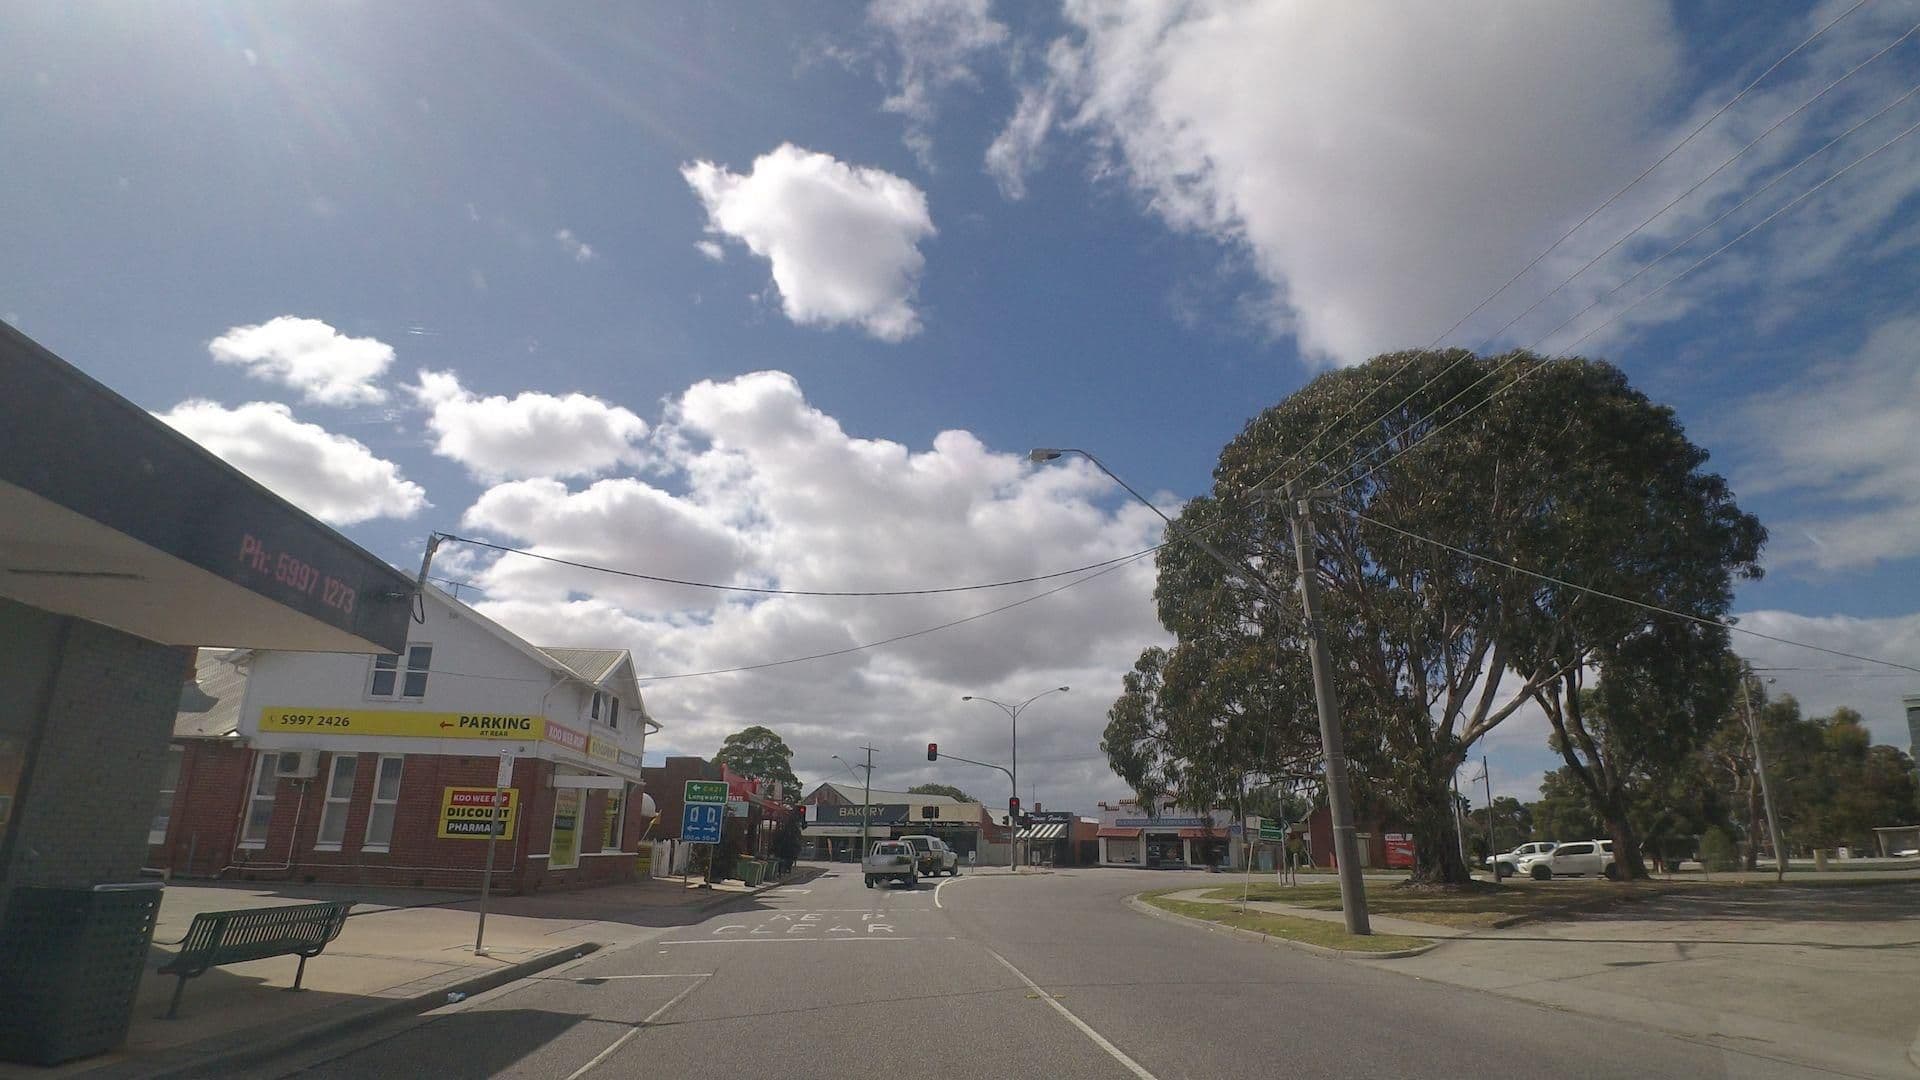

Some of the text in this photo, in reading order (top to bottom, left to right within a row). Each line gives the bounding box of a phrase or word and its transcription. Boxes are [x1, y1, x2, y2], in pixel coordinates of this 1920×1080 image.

[240, 533, 355, 614] Ph: 5997 1273
[281, 714, 350, 728] 5997 2426
[459, 716, 531, 731] PARKING
[549, 725, 562, 739] KOO
[453, 793, 509, 804] KOO WEE RP
[839, 807, 886, 817] BAKRY
[448, 823, 504, 834] PHARMA
[768, 913, 885, 921] KEP
[712, 924, 895, 933] CLEAR
